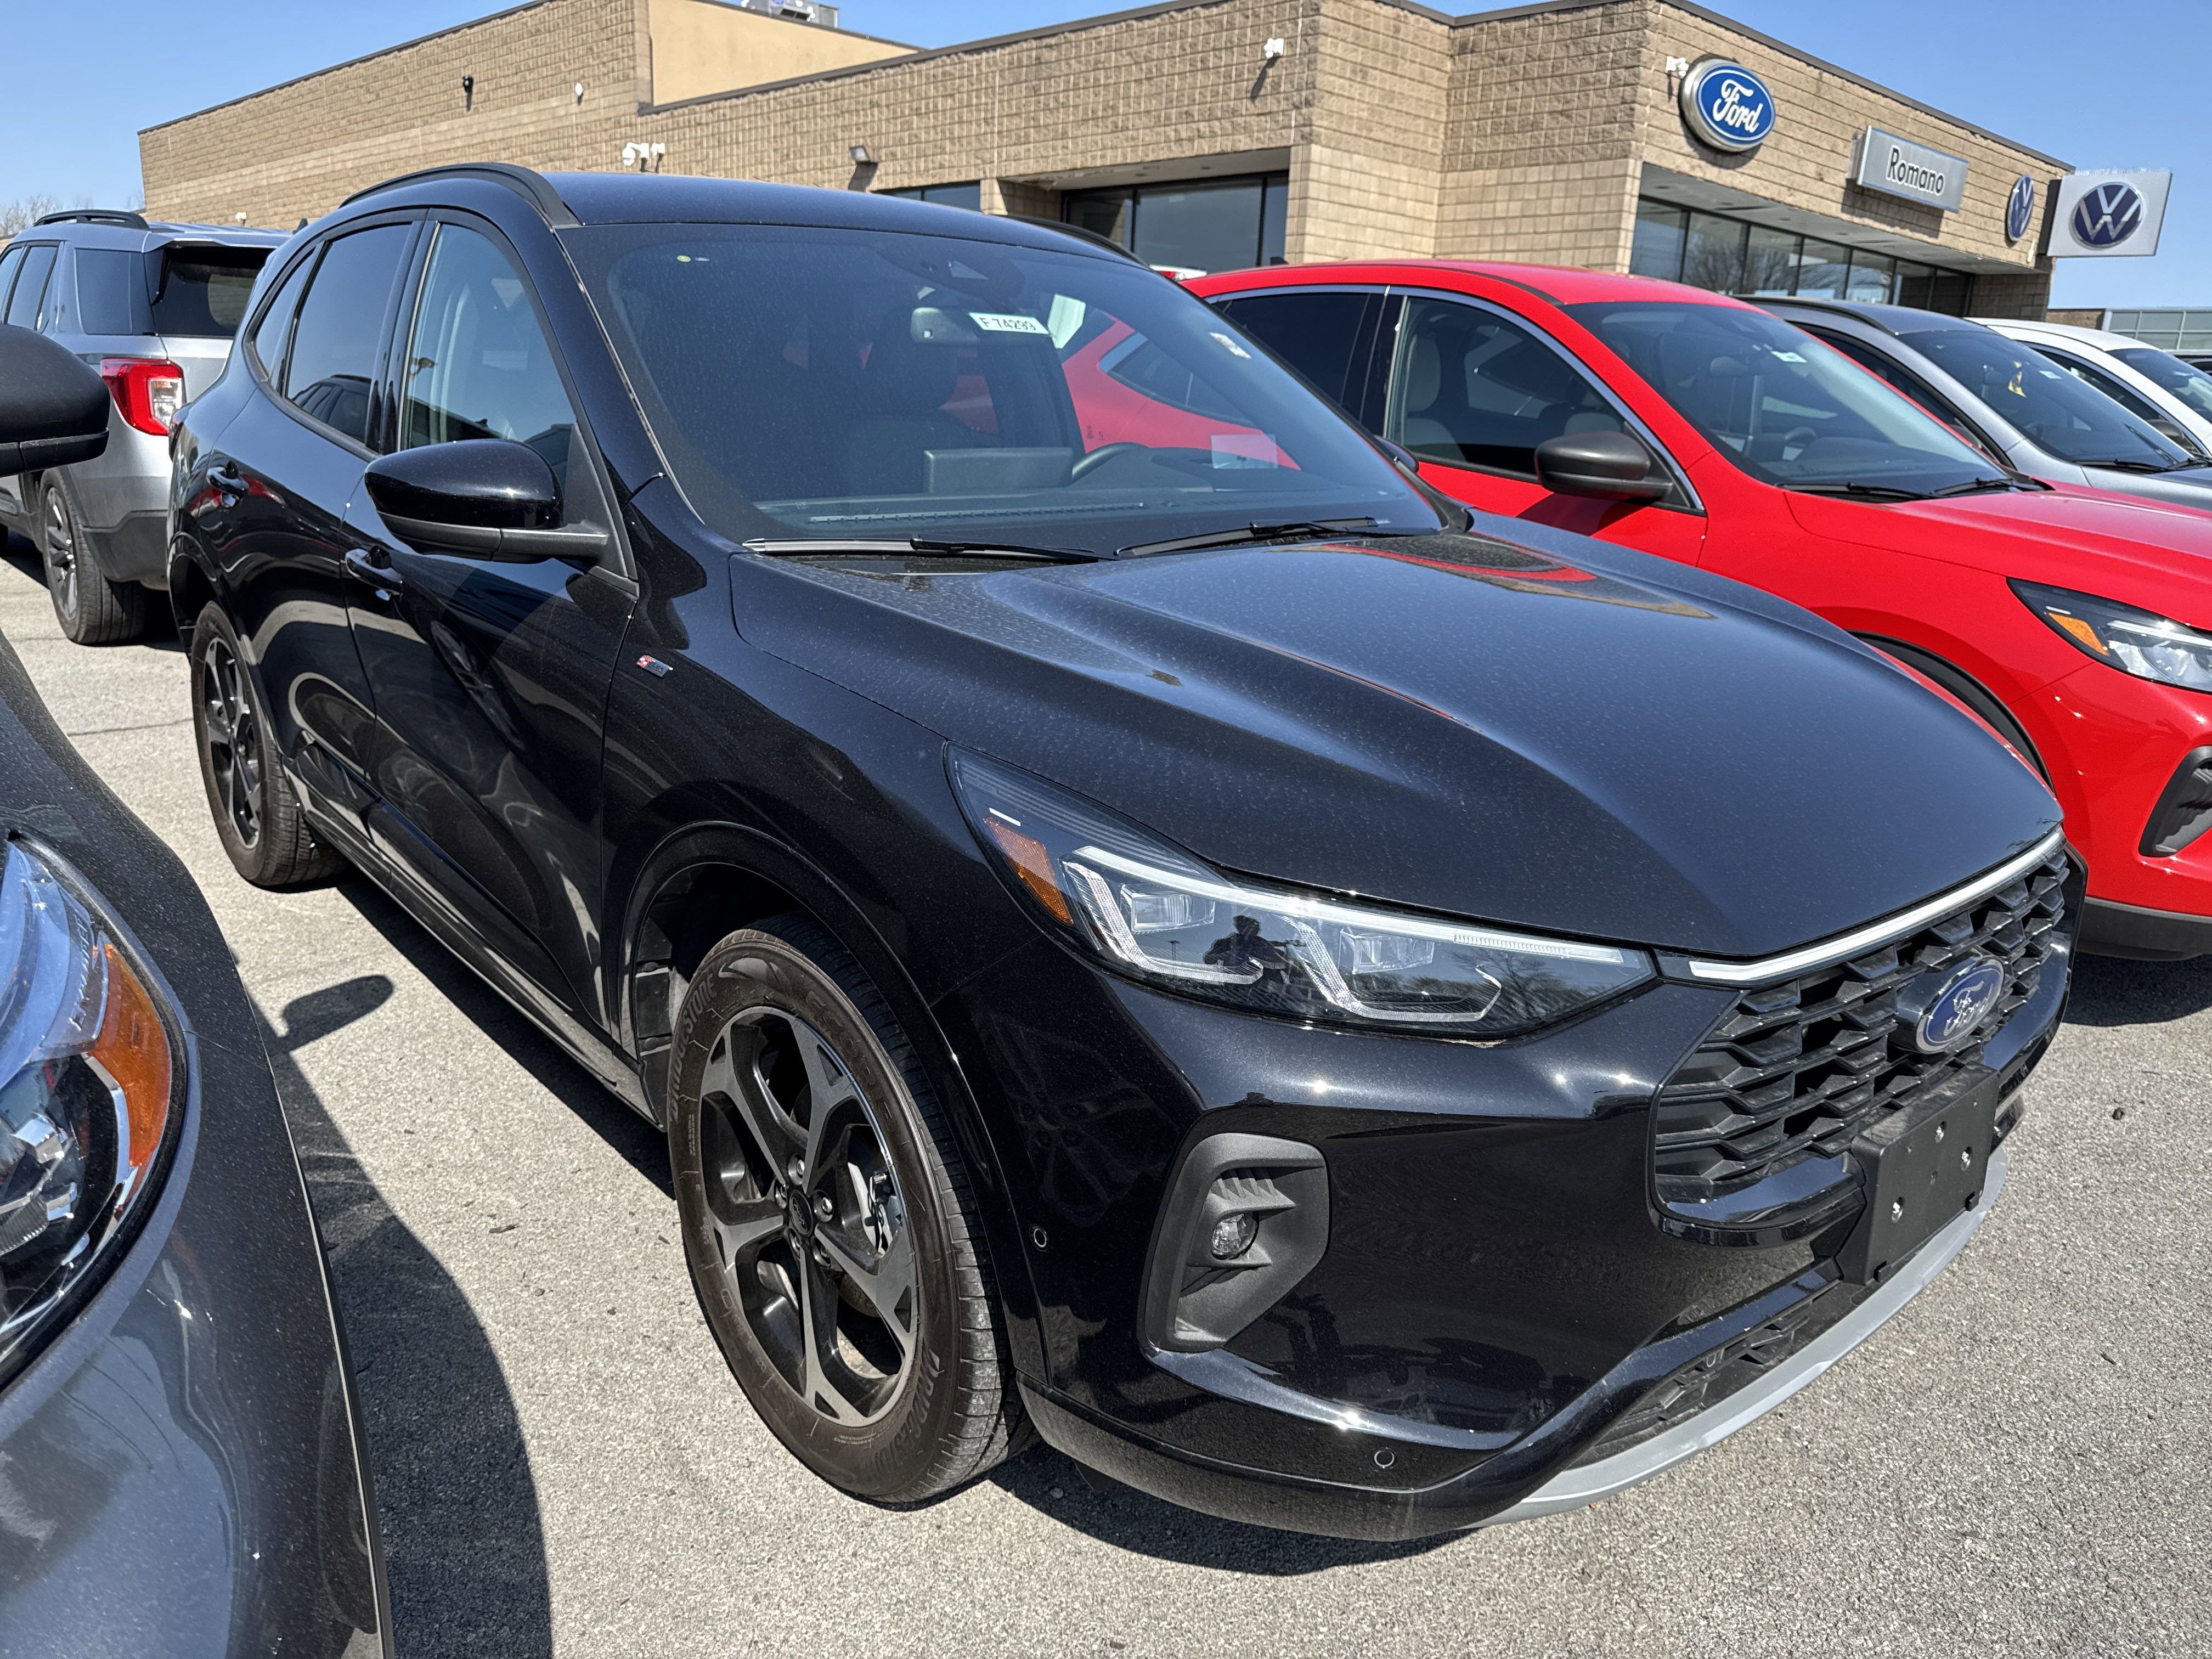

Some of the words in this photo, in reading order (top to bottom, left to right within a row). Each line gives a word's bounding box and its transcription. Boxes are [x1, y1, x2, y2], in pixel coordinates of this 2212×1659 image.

[1712, 79, 1763, 133] Ford
[1886, 145, 1945, 196] Romano
[2077, 183, 2142, 240] VW
[979, 317, 990, 328] F
[992, 318, 1036, 331] 74299
[1943, 980, 1993, 1036] Ford
